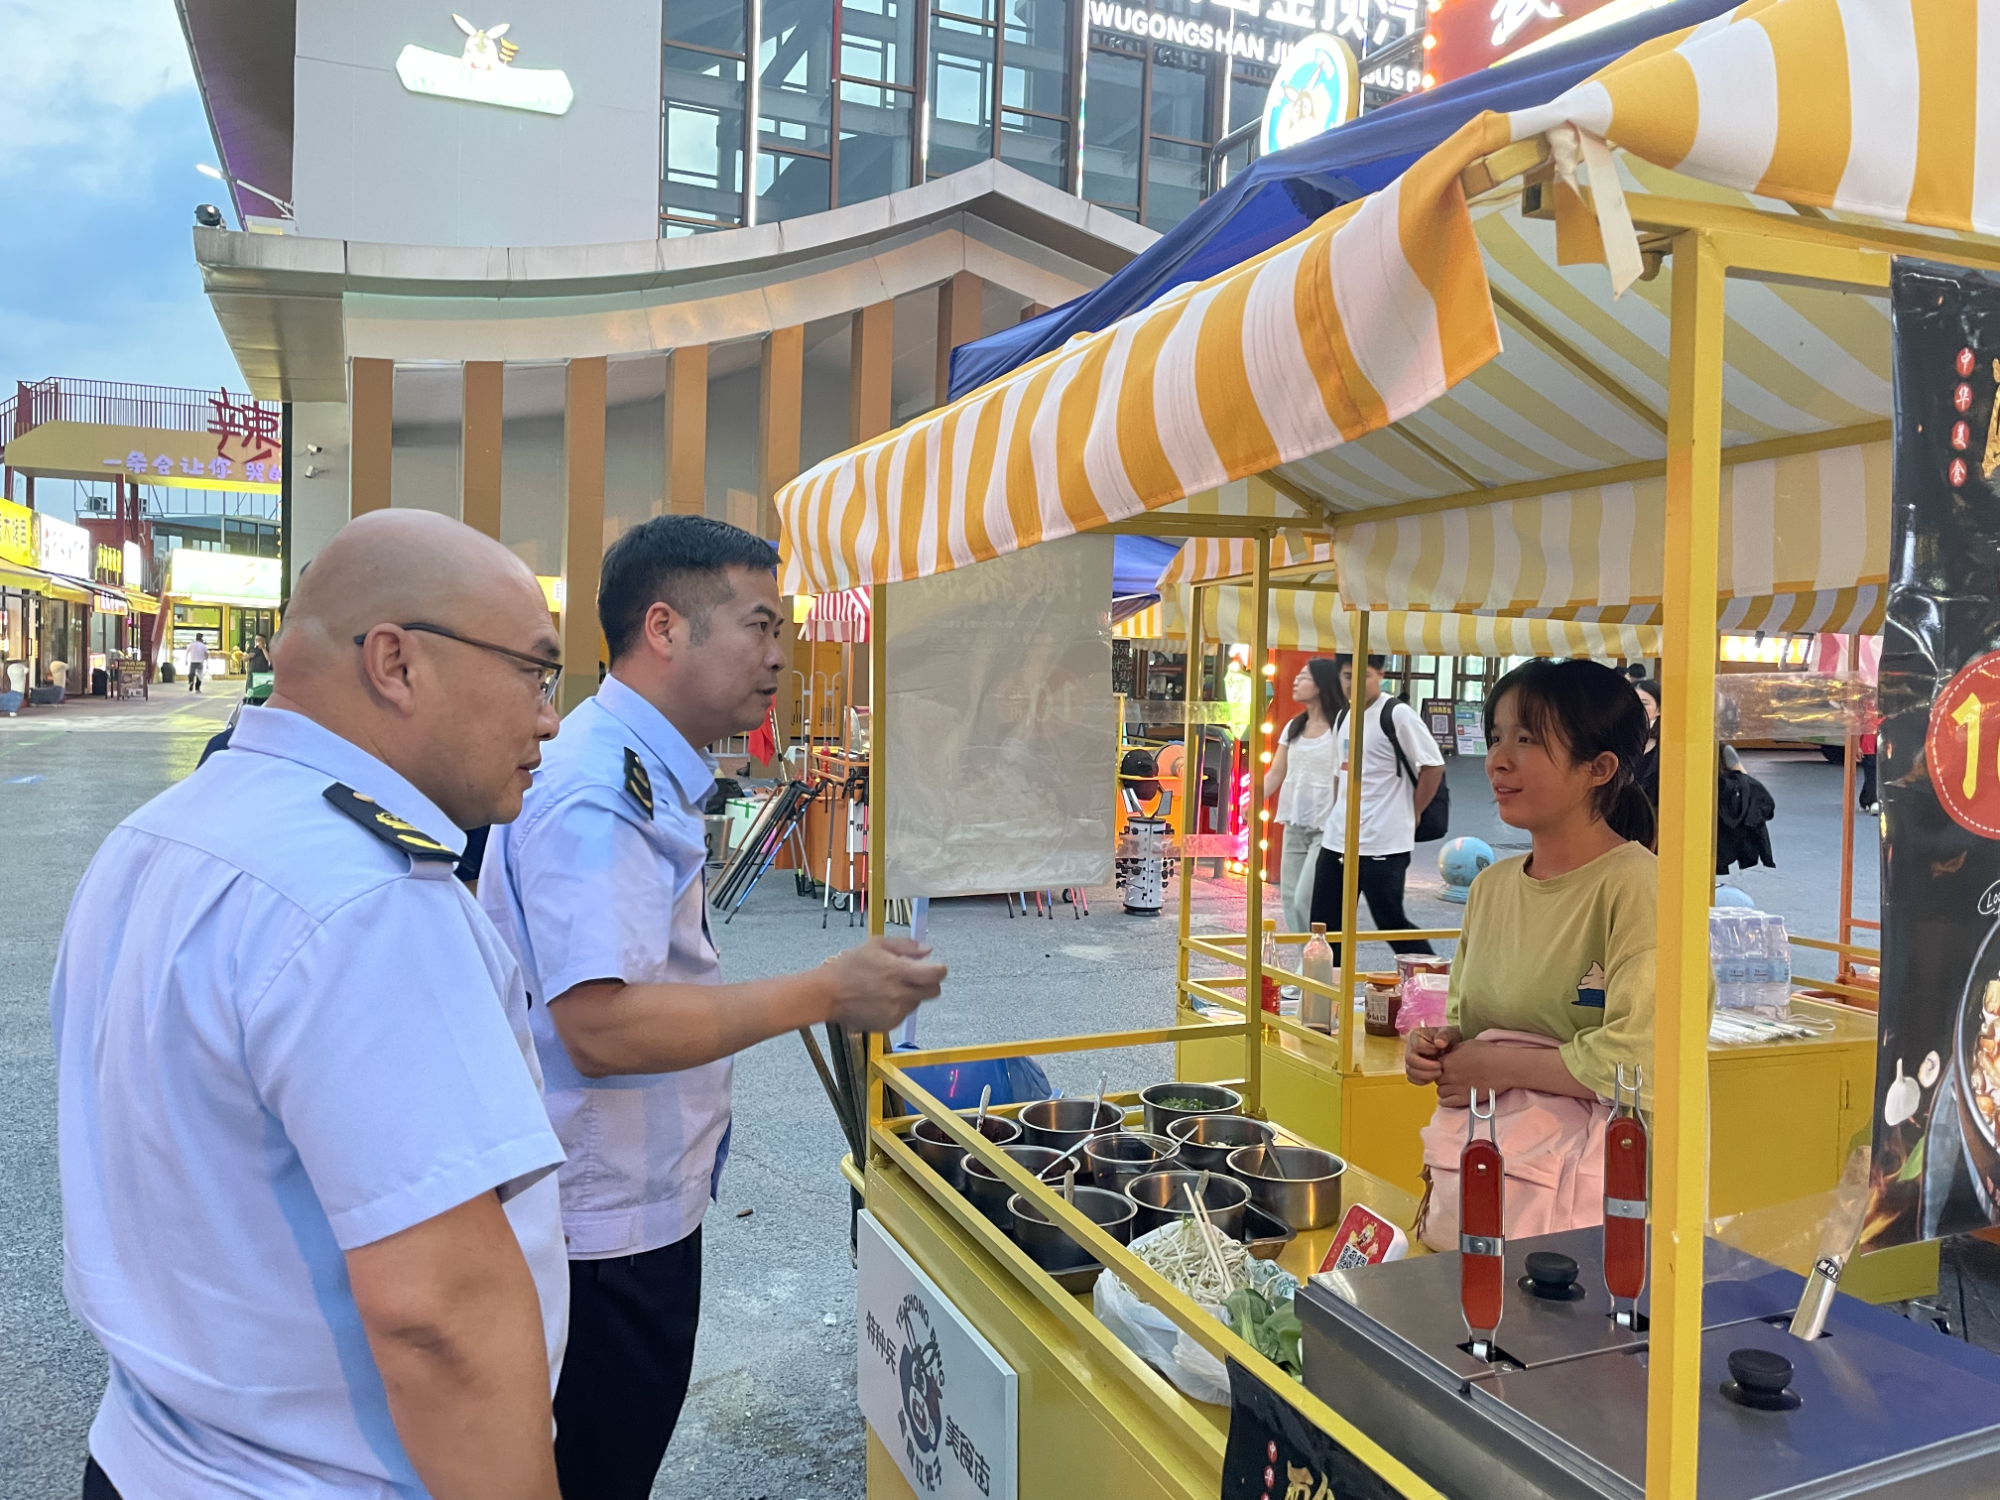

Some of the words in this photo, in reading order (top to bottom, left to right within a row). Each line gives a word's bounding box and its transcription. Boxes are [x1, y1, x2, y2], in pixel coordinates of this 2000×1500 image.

[1089, 1, 1265, 62] WUGONGSHAN
[207, 386, 282, 450] 辣
[866, 1309, 897, 1376] 特种兵
